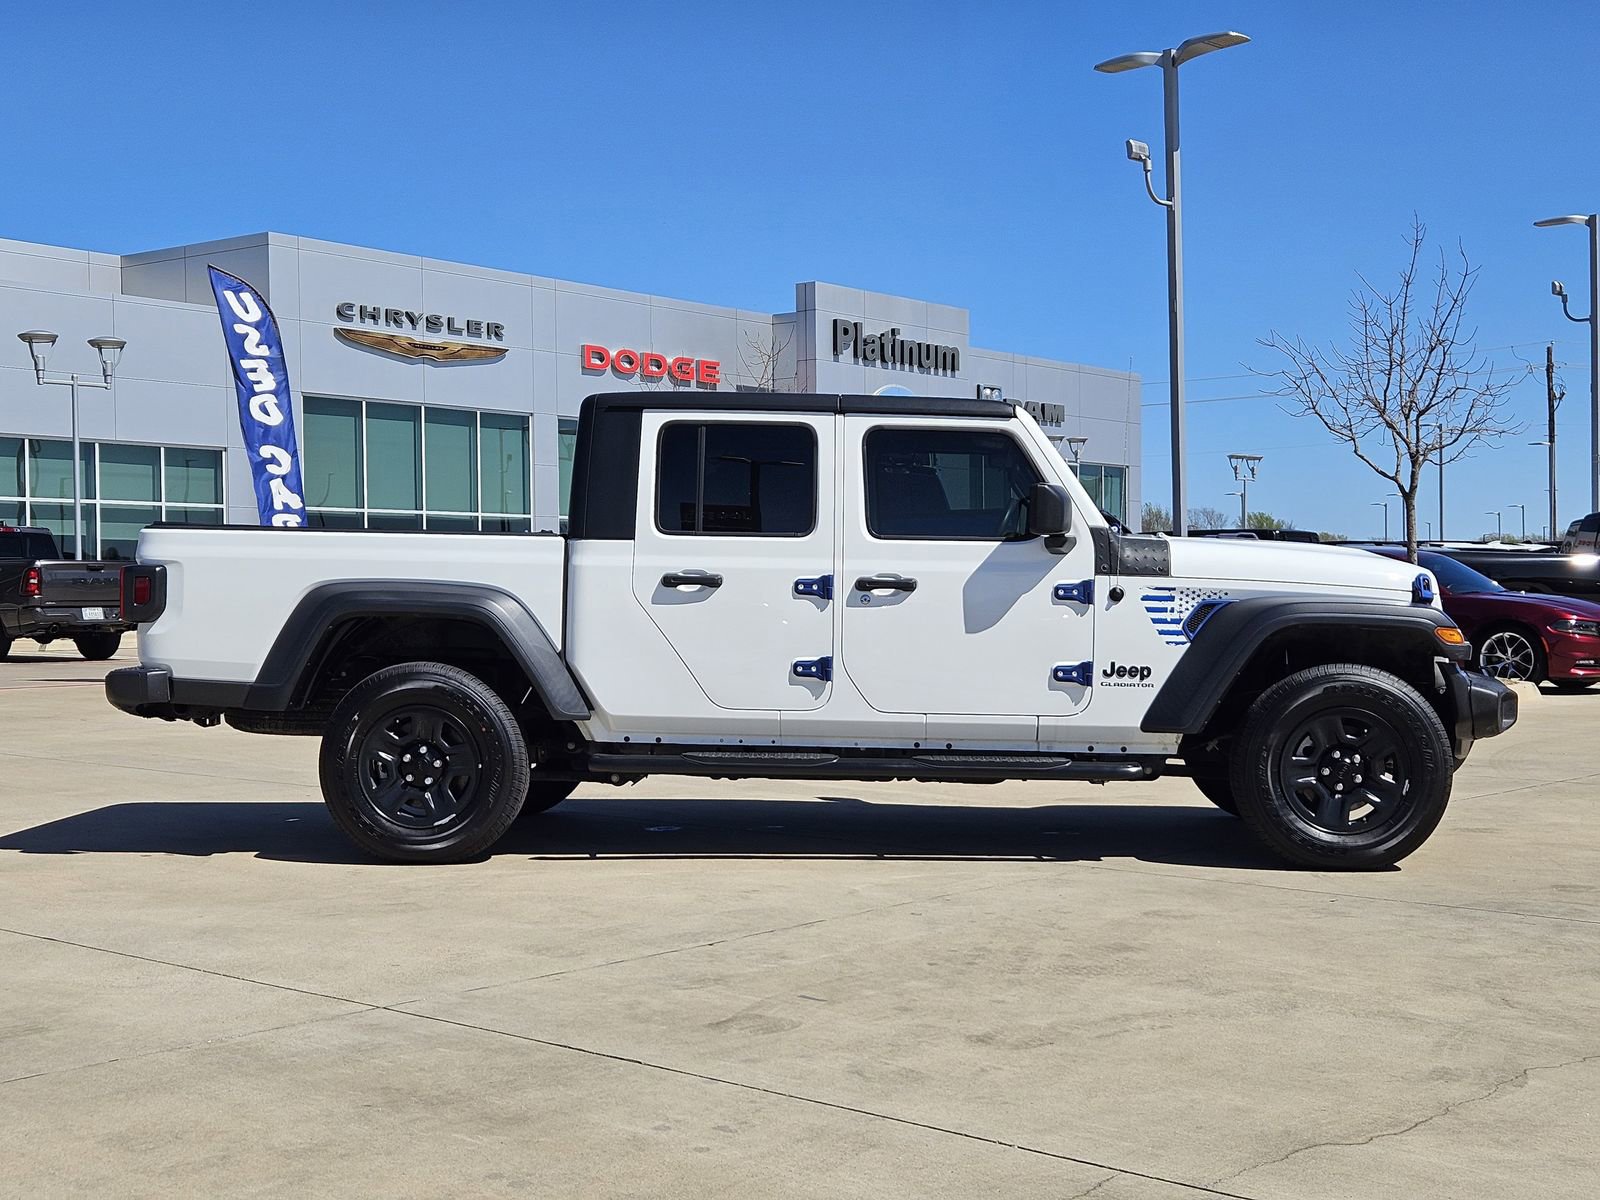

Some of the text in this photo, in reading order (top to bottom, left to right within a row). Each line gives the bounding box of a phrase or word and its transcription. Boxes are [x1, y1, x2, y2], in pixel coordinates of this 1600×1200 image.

[336, 302, 505, 341] CHRYSLER
[581, 343, 721, 385] DODGE
[832, 318, 961, 373] Platinum
[1102, 661, 1152, 682] Jeep
